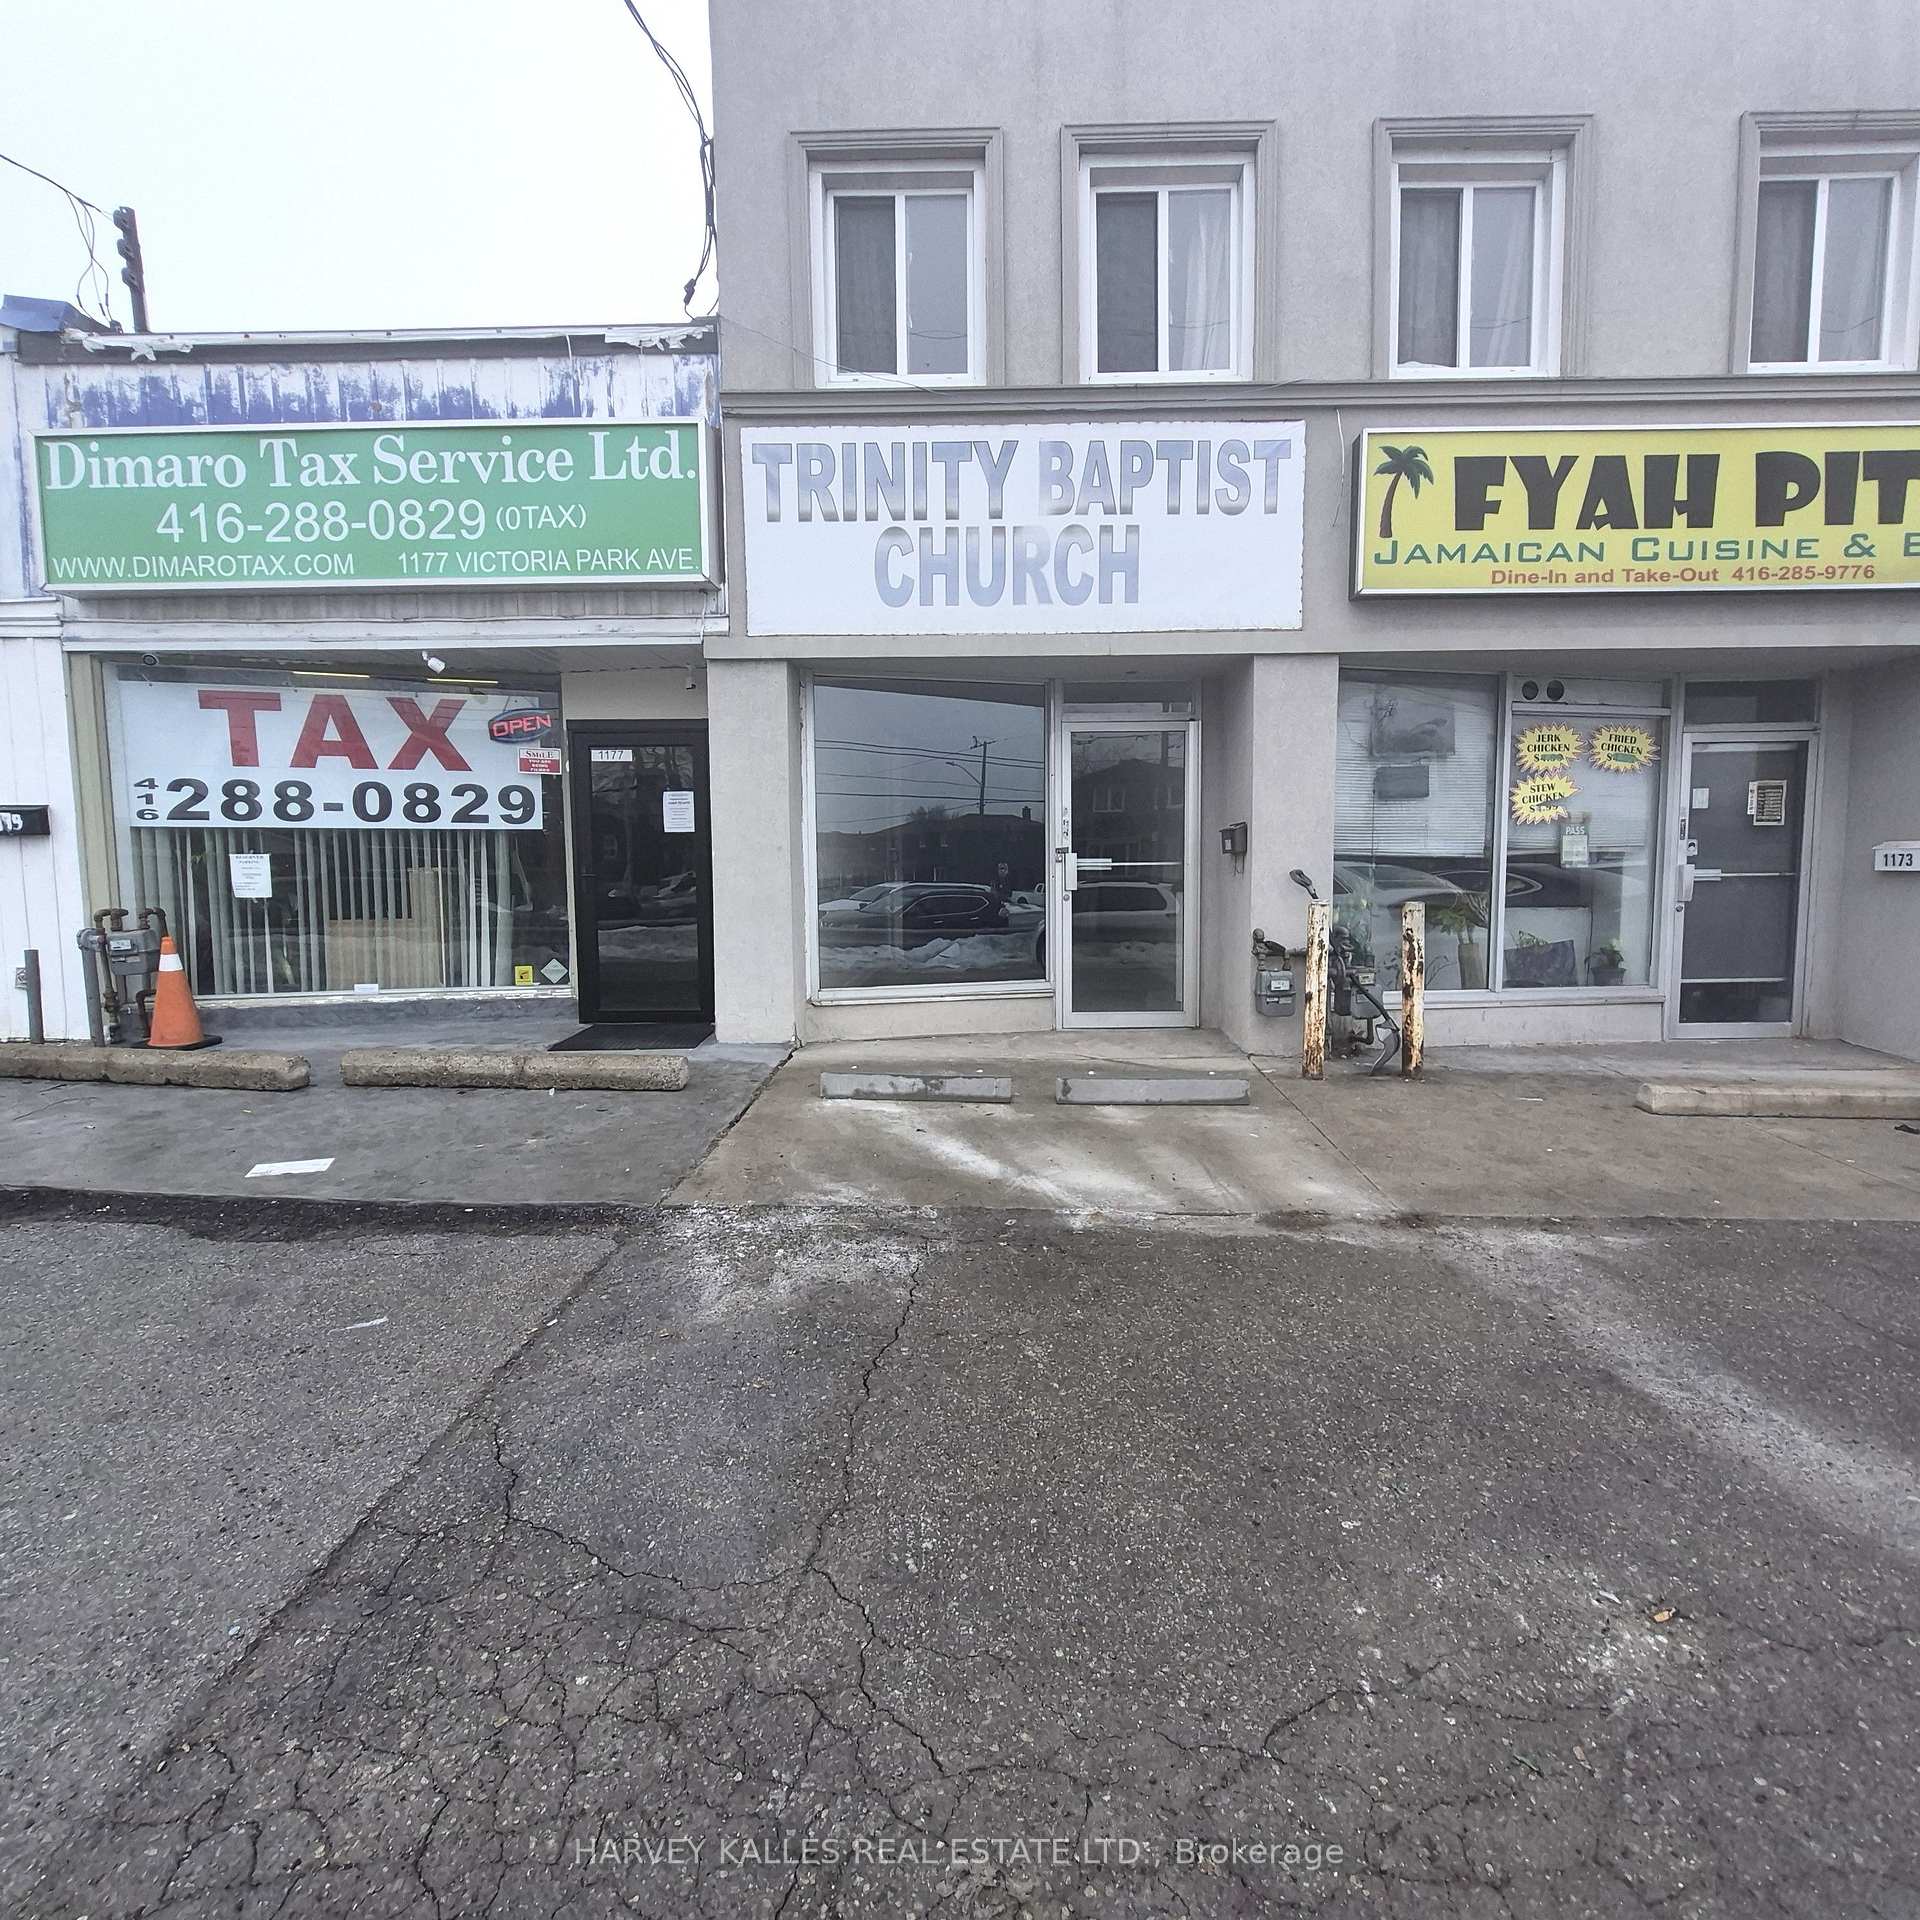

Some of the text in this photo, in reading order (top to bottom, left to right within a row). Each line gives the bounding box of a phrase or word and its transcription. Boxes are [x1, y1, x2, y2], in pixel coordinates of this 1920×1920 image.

[42, 429, 697, 490] Dimaro Tax Service Ltd.
[751, 439, 1292, 522] TRINITY BAPTIST
[1454, 449, 1920, 531] FYAH PIT
[156, 498, 486, 544] 416-288-0829
[1374, 540, 1605, 565] JAMAICAN
[1631, 537, 1820, 562] CUISINE
[1843, 533, 1877, 558] &
[52, 547, 699, 578] WWW.DIMAROTAX.COM 1177 VICTORIA PARK AVE.
[874, 524, 1140, 607] CHURCH
[1491, 564, 1876, 584] Dine-In and Take-Out 416-285-9776
[197, 688, 473, 772] TAX
[492, 714, 552, 737] OPEN
[1527, 743, 1571, 752] CHICKEN
[1535, 733, 1561, 742] JERK
[1608, 733, 1637, 744] FRIED
[599, 750, 624, 760] 1177
[1600, 742, 1643, 755] CHICKEN
[1521, 792, 1565, 805] CHICKEN
[1530, 783, 1556, 793] STEW
[166, 777, 537, 825] 288-0829
[1565, 825, 1585, 836] PASS
[1883, 853, 1913, 867] 1173
